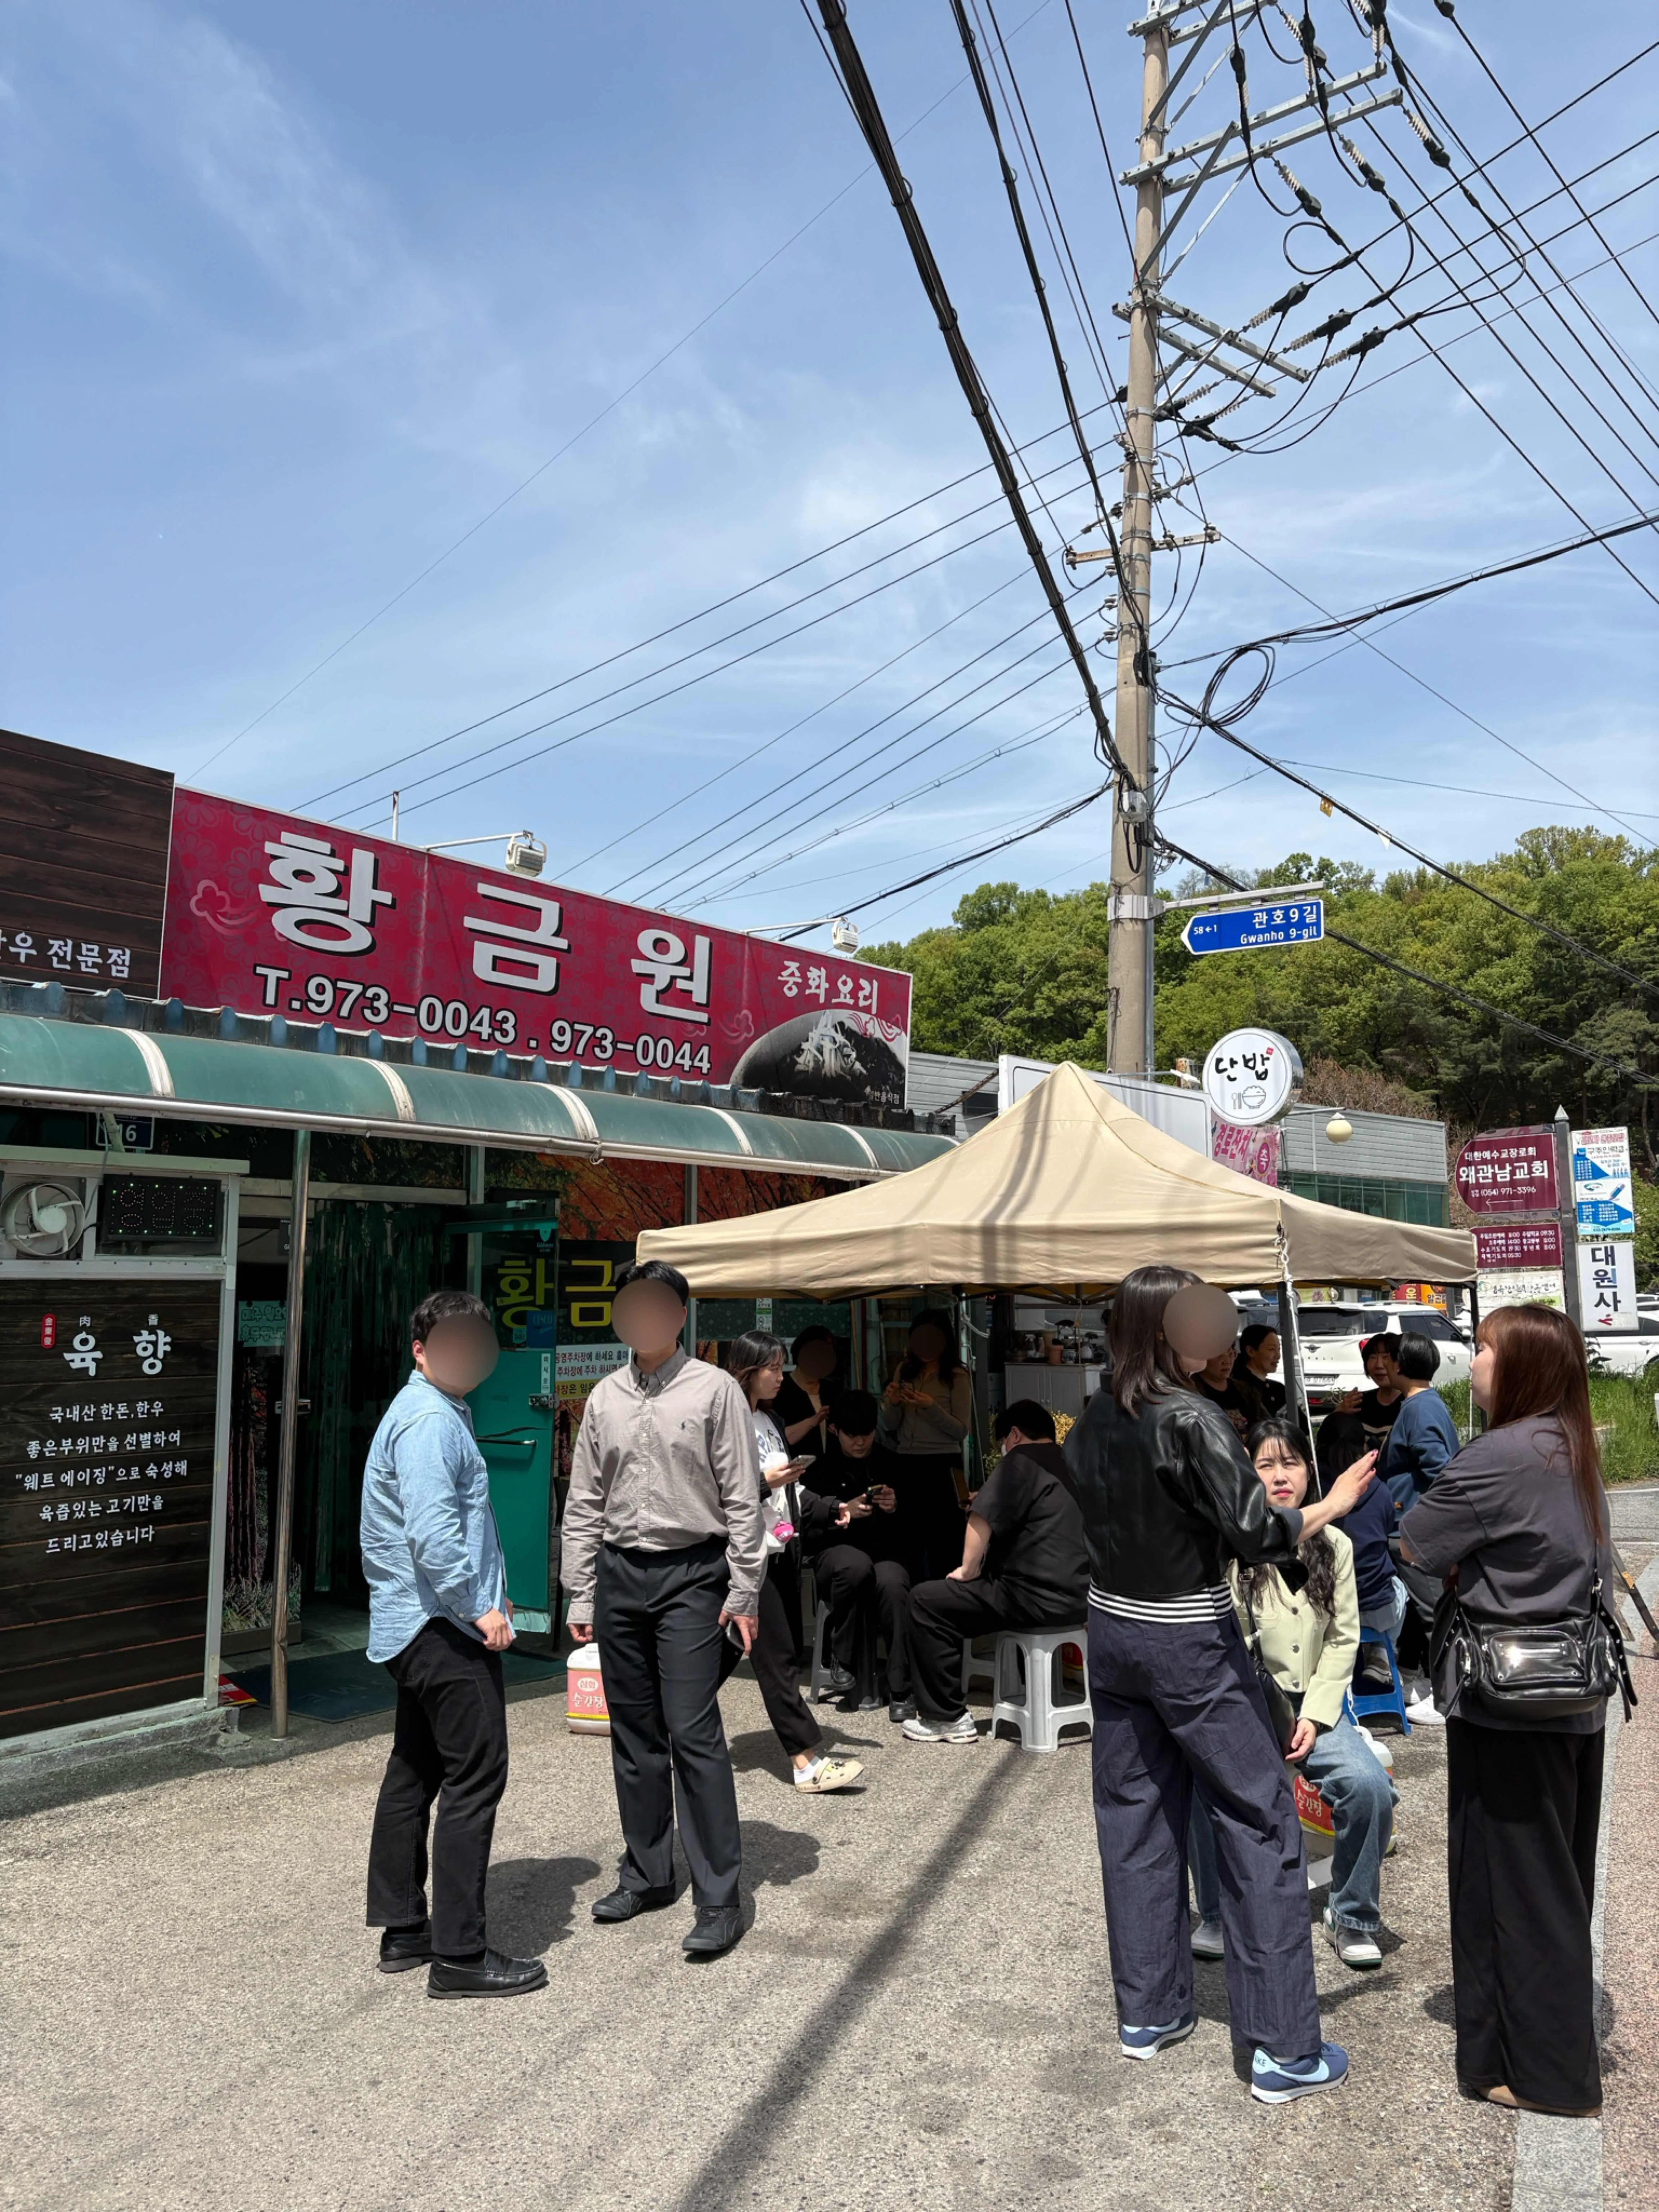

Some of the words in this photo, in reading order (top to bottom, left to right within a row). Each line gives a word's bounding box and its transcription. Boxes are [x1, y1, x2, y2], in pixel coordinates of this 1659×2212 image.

[1194, 926, 1204, 935] 58
[1241, 930, 1284, 945] Gwanho
[1289, 926, 1317, 941] 9-gil
[47, 938, 131, 978] 전문점
[777, 961, 878, 1015] 중화요리
[551, 1020, 711, 1074] 973-0044
[1215, 1052, 1271, 1082] 단밥
[1464, 1146, 1537, 1161] 대한예수교장로회
[1459, 1160, 1548, 1184] 왜관남교회
[1501, 1186, 1536, 1195] 971-3396
[120, 1187, 208, 1229] 영업중
[1591, 1245, 1622, 1312] 대원사
[79, 1316, 91, 1327] 肉
[557, 1365, 583, 1377] 주차장에
[584, 1364, 597, 1375] 주차
[49, 1404, 96, 1423] 국내산
[26, 1435, 119, 1458] 좋은부위만을
[124, 1430, 181, 1450] 선별하여
[145, 1460, 188, 1479] 숙성해
[106, 1494, 164, 1514] 고기만을
[46, 1525, 155, 1554] 드리고있습니다
[571, 1692, 606, 1709] 순간장
[1296, 1788, 1323, 1817] 순간장
